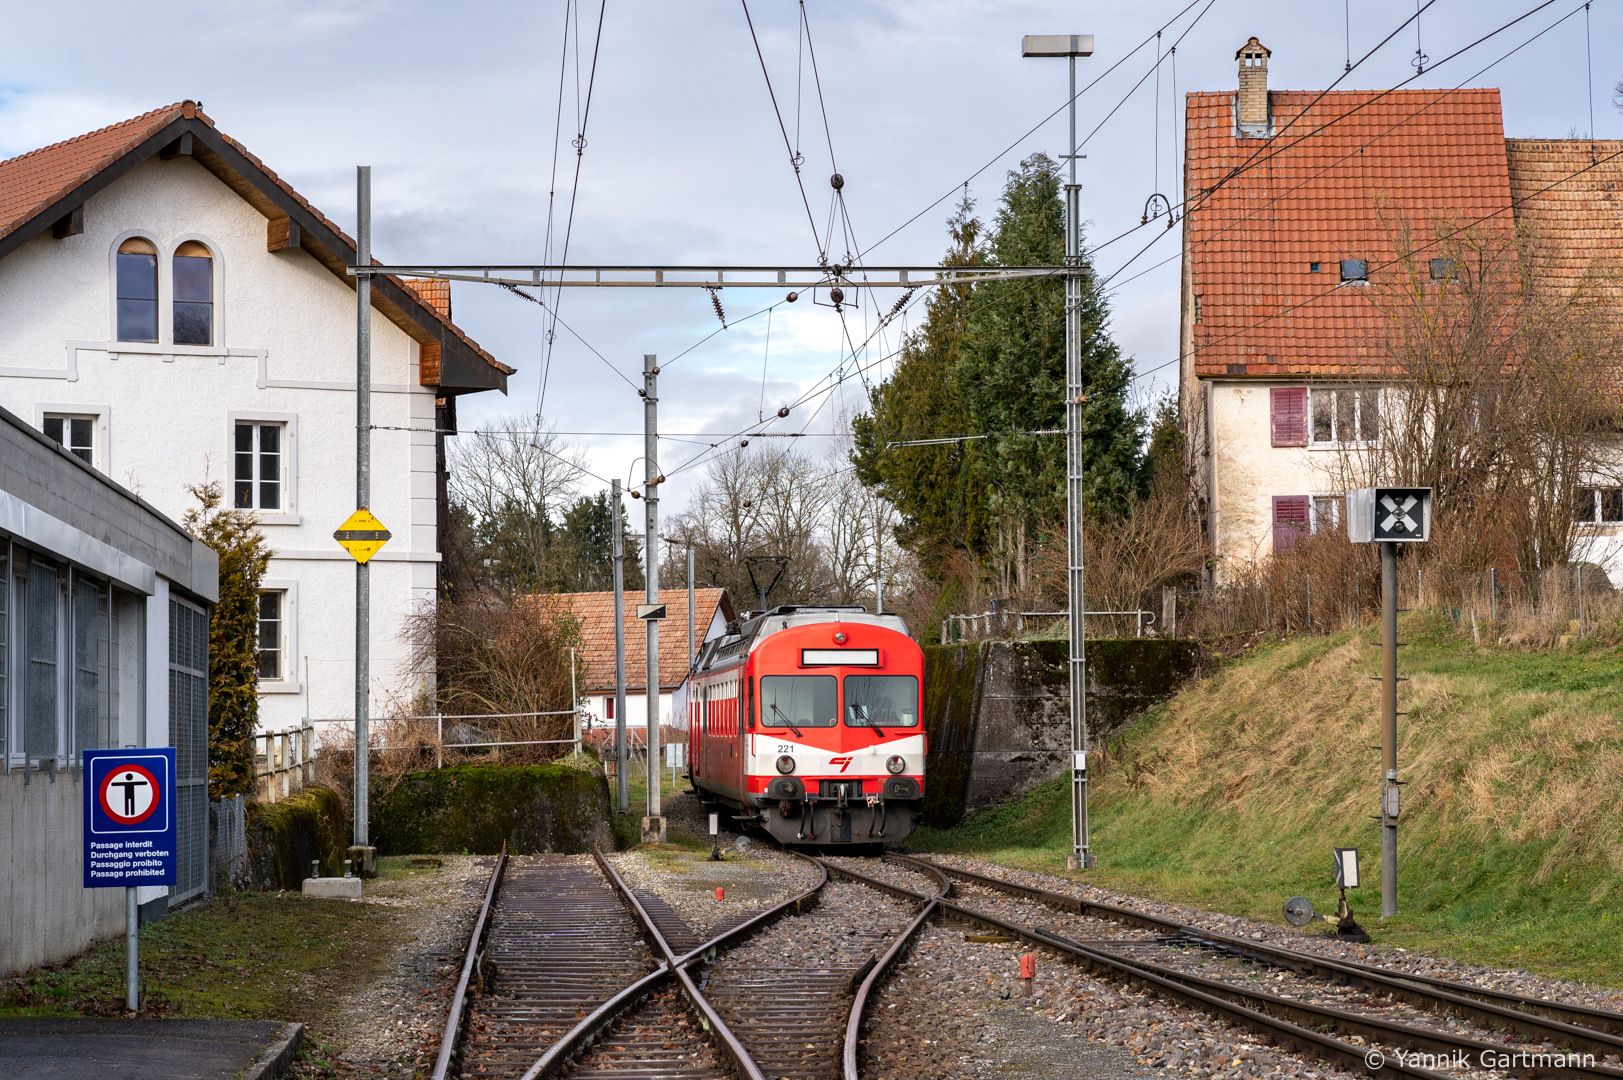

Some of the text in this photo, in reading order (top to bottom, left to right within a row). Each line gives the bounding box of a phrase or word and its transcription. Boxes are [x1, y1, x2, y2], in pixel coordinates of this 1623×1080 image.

[777, 744, 794, 753] 221
[90, 840, 153, 850] Passage interdit
[90, 851, 133, 859] Durchgang
[90, 859, 163, 869] Passaggio proibito
[90, 868, 165, 878] Passage prohibited
